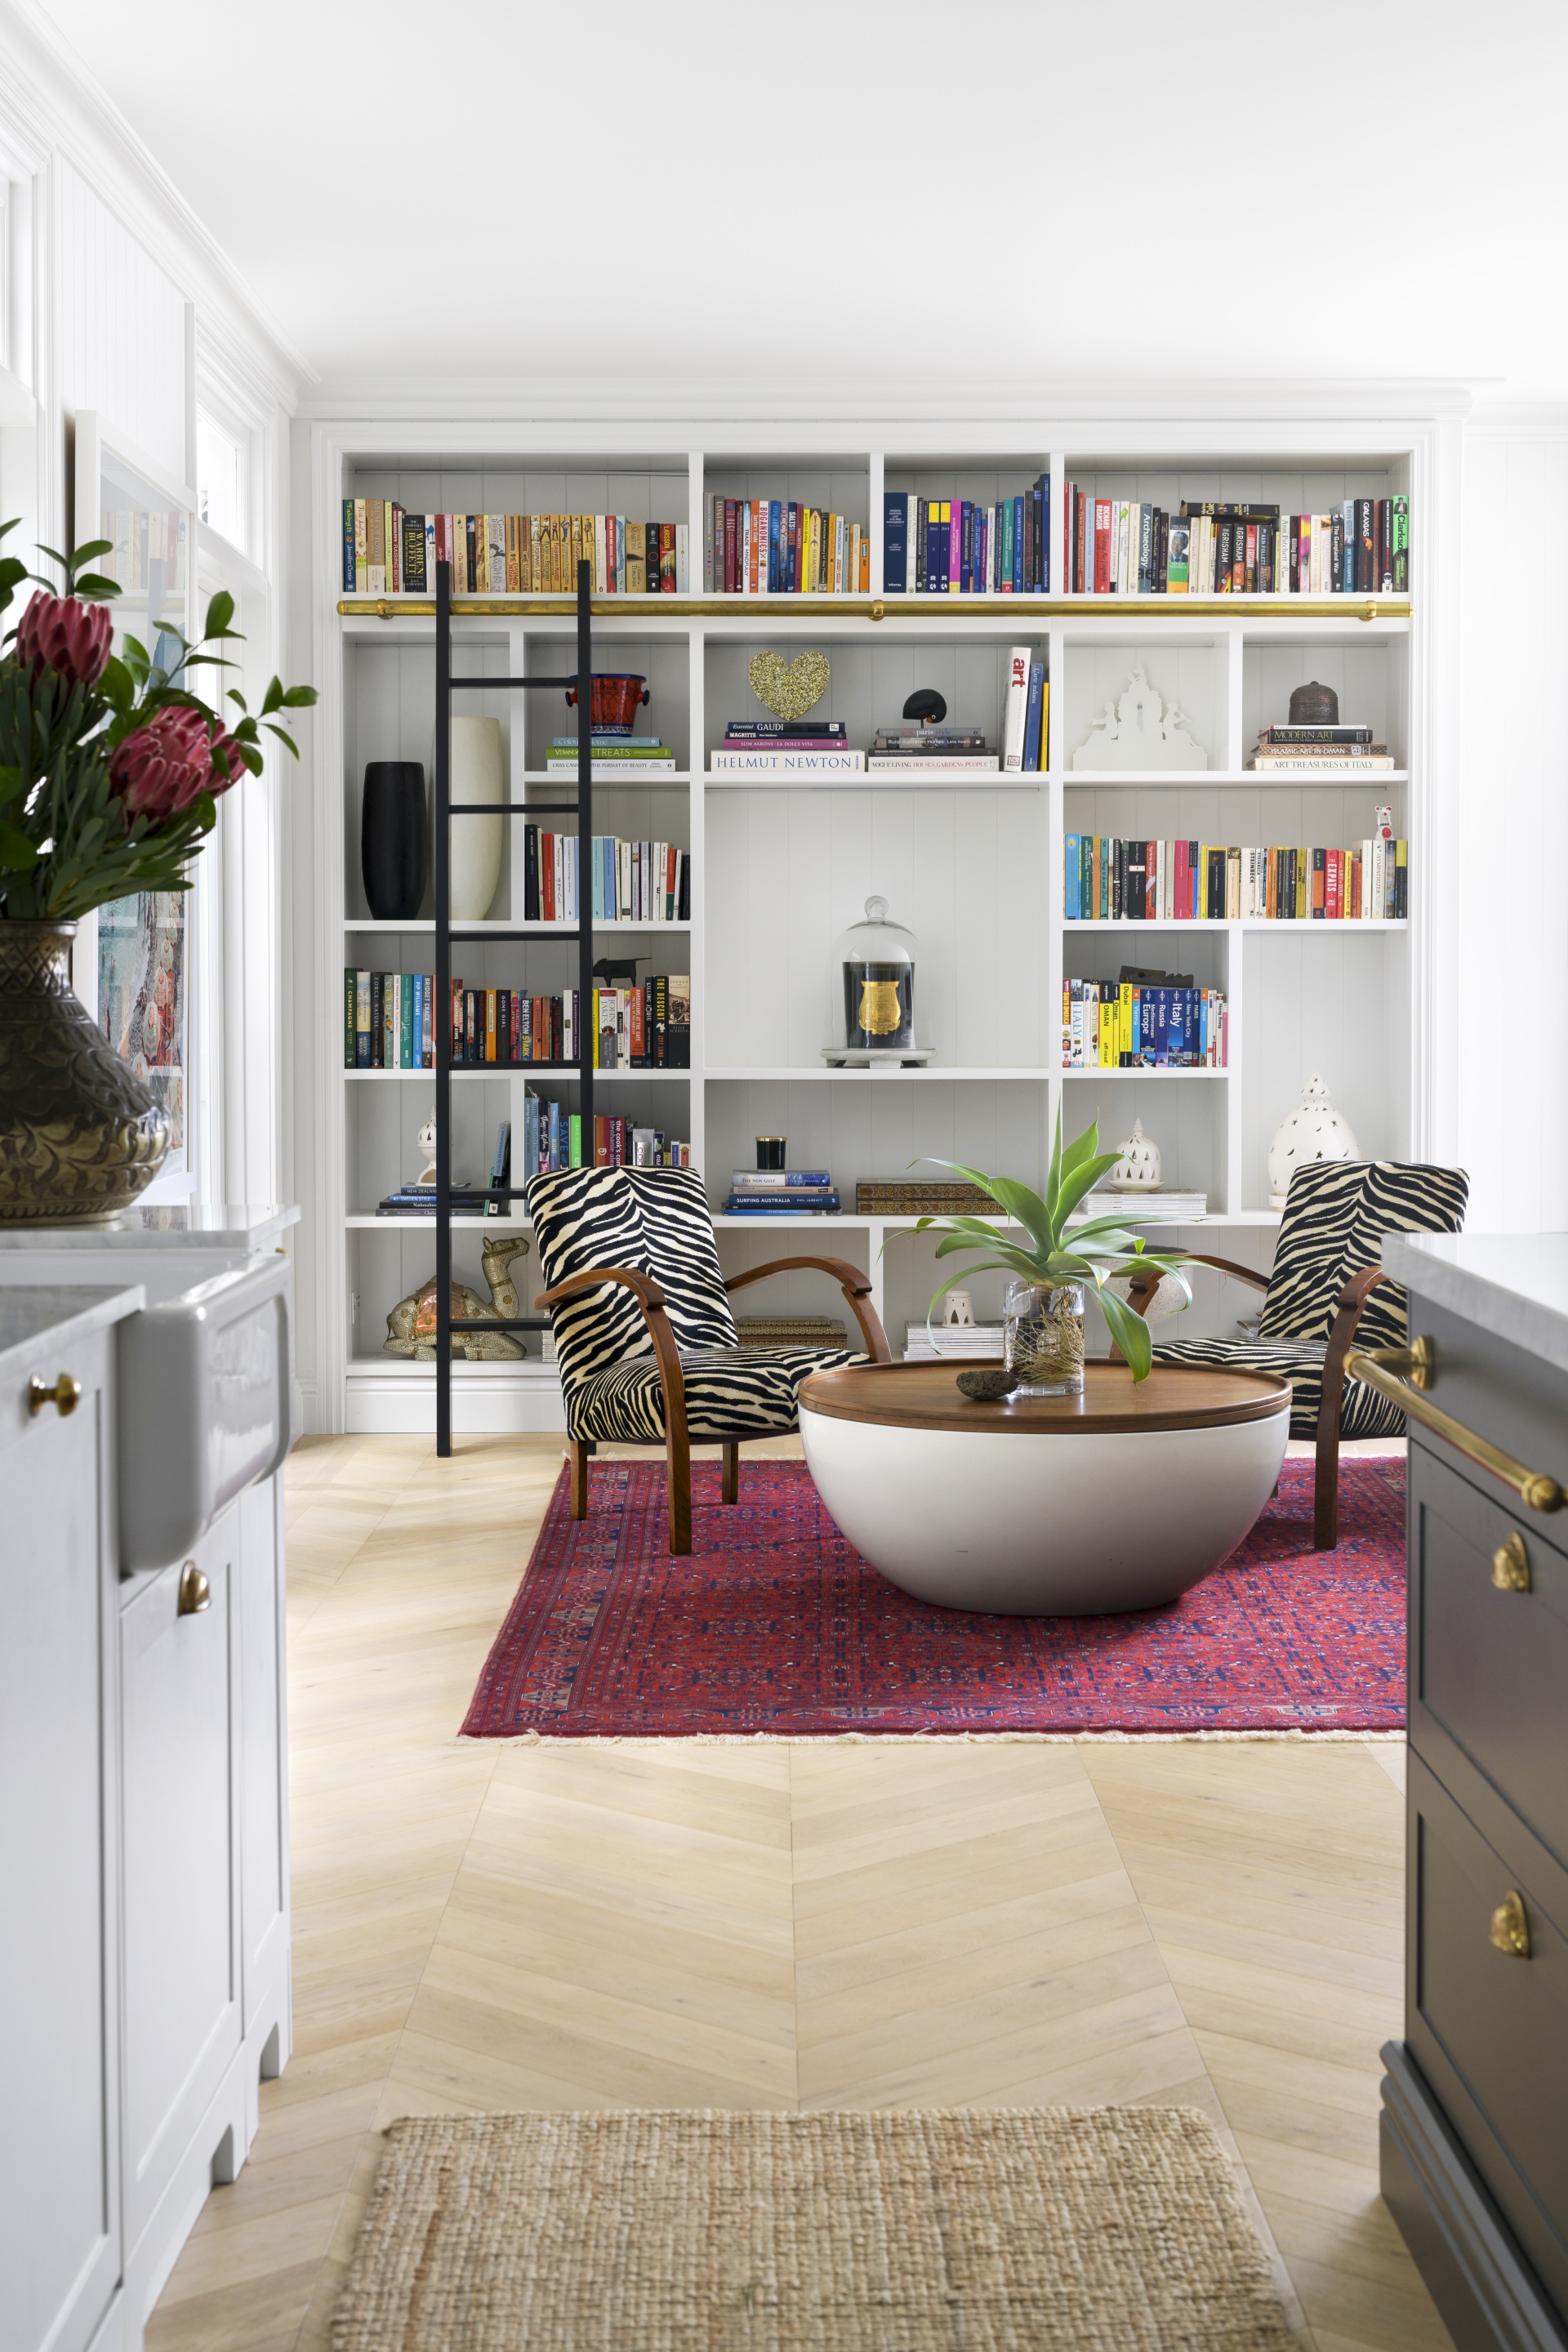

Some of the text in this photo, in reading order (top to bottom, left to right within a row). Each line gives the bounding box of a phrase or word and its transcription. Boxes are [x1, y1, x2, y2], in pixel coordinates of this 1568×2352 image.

[374, 526, 381, 534] OF
[715, 501, 724, 531] LANGUAGE
[760, 507, 768, 553] BOGANOMICS
[408, 532, 416, 575] BUFFETT
[416, 532, 424, 574] WARREN
[1141, 514, 1151, 568] Archaeology
[1222, 532, 1230, 563] GRISHAM
[1236, 530, 1244, 561] GRISHAM
[1012, 657, 1026, 688] art
[916, 729, 934, 737] paris
[935, 729, 951, 737] style
[1274, 731, 1334, 739] MODERN ART
[717, 757, 852, 768] HELMUT NEWTON
[1327, 863, 1337, 892] EXPATS
[657, 978, 665, 1021] THE DESCENT
[1169, 1003, 1183, 1027] Italy
[1072, 1004, 1082, 1037] ITALY
[1141, 1004, 1151, 1034] Europe
[559, 1121, 568, 1152] SAVE
